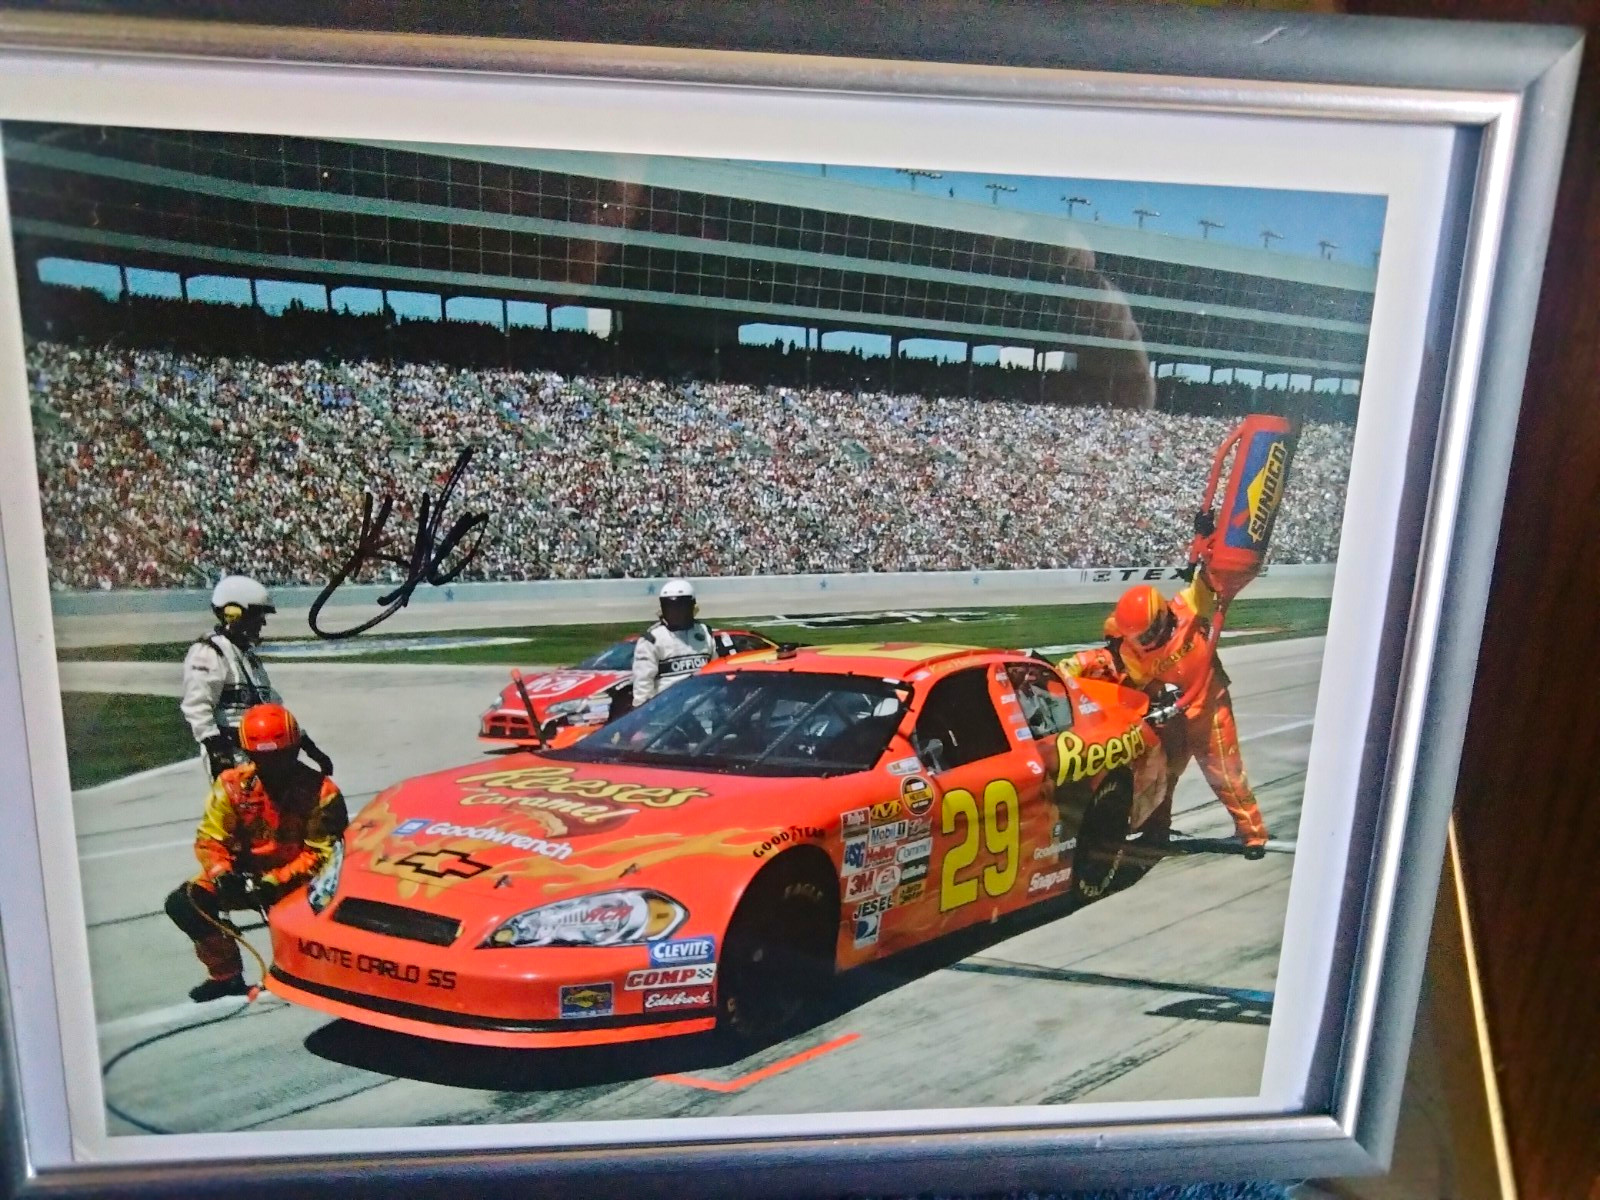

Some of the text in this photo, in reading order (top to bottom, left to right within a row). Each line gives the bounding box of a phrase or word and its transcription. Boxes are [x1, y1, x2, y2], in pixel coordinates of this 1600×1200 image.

[1251, 445, 1286, 540] SUNOCO
[459, 789, 640, 823] Caramel
[425, 821, 574, 860] Goodwrench
[940, 779, 1019, 912] 29
[849, 870, 875, 896] 3M
[854, 895, 893, 919] JESEL
[298, 938, 457, 990] MONTE CARLO SS
[653, 941, 709, 959] CLEVITE
[627, 968, 697, 988] COMP
